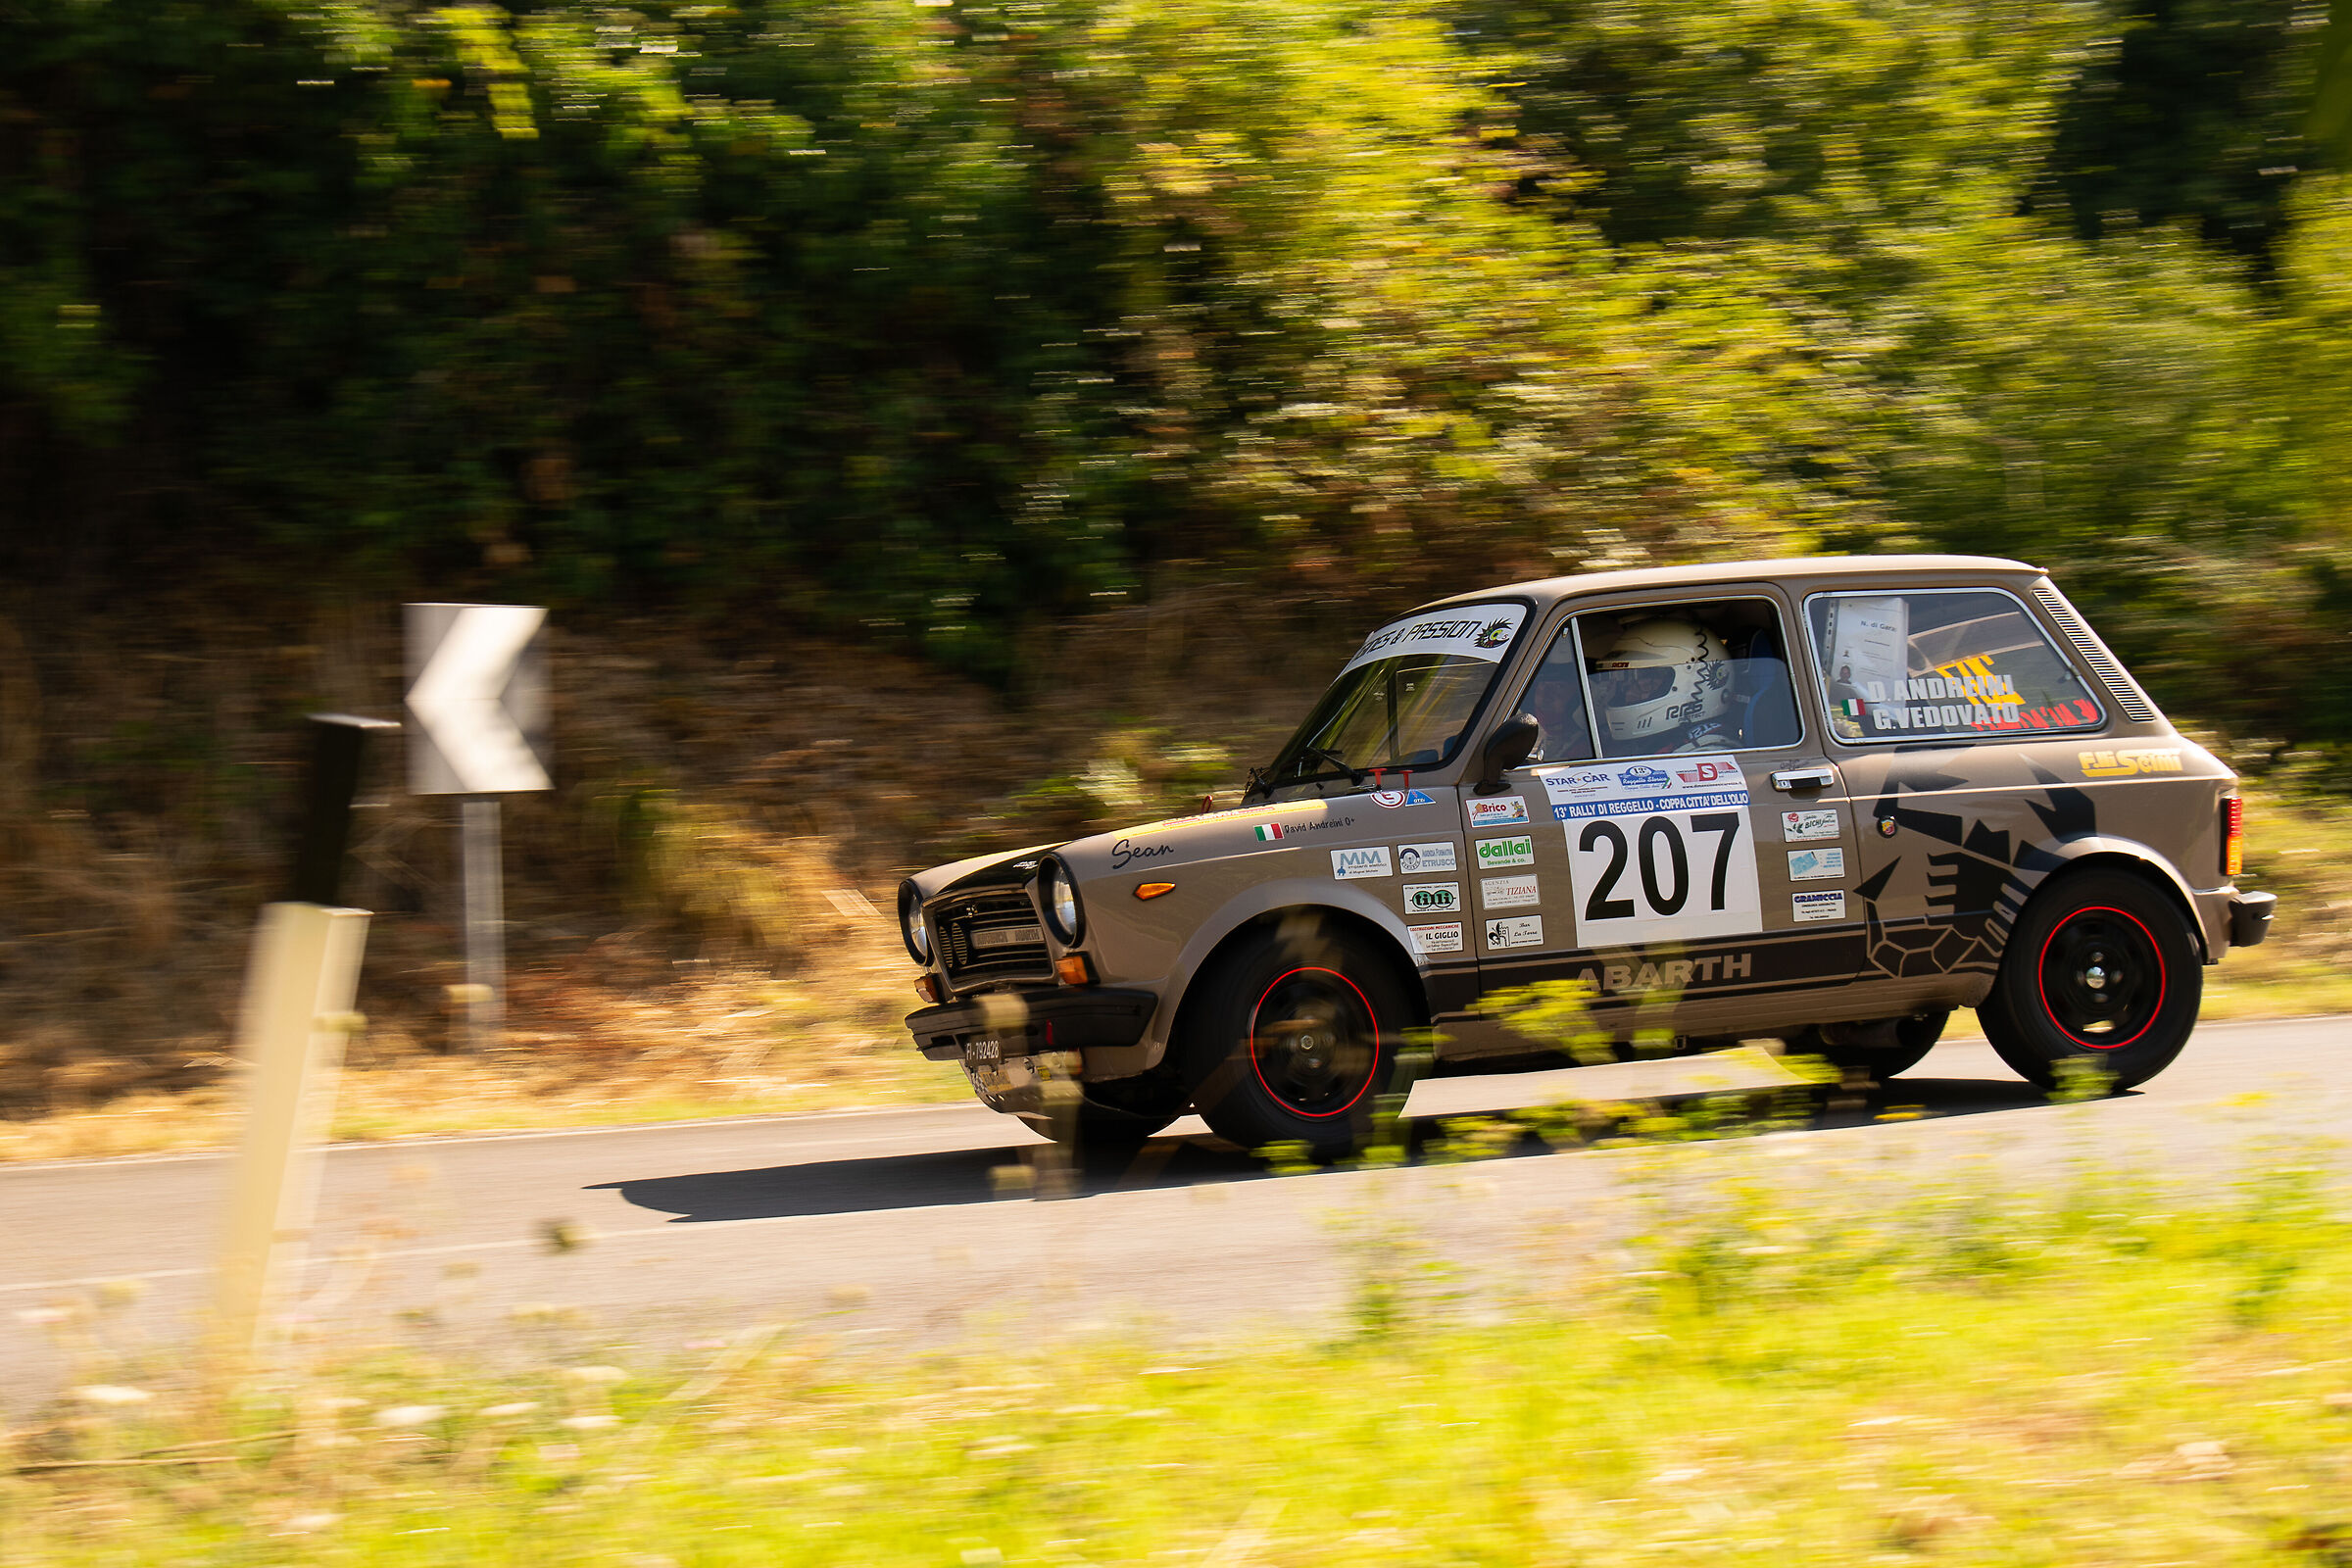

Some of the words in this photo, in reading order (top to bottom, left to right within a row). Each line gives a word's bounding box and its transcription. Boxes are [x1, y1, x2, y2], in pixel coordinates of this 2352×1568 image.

[1401, 620, 1482, 643] PASSION
[1872, 702, 2021, 730] G.VEDOVATO
[1545, 777, 1577, 786] STAR
[1583, 773, 1611, 783] CAR
[1482, 803, 1506, 812] Brico
[1569, 804, 1595, 817] RALLY
[1597, 803, 1608, 815] DI
[1608, 800, 1654, 814] REGGELLO
[1659, 798, 1687, 810] COPPA
[1285, 822, 1306, 833] David
[1309, 818, 1344, 830] Andreini
[1112, 839, 1174, 869] Sean
[1341, 851, 1382, 865] MM
[1422, 858, 1455, 867] ETRUSCO
[1579, 812, 1740, 921] 207
[1506, 886, 1537, 896] TIZIANA
[1576, 953, 1751, 992] ABARTH
